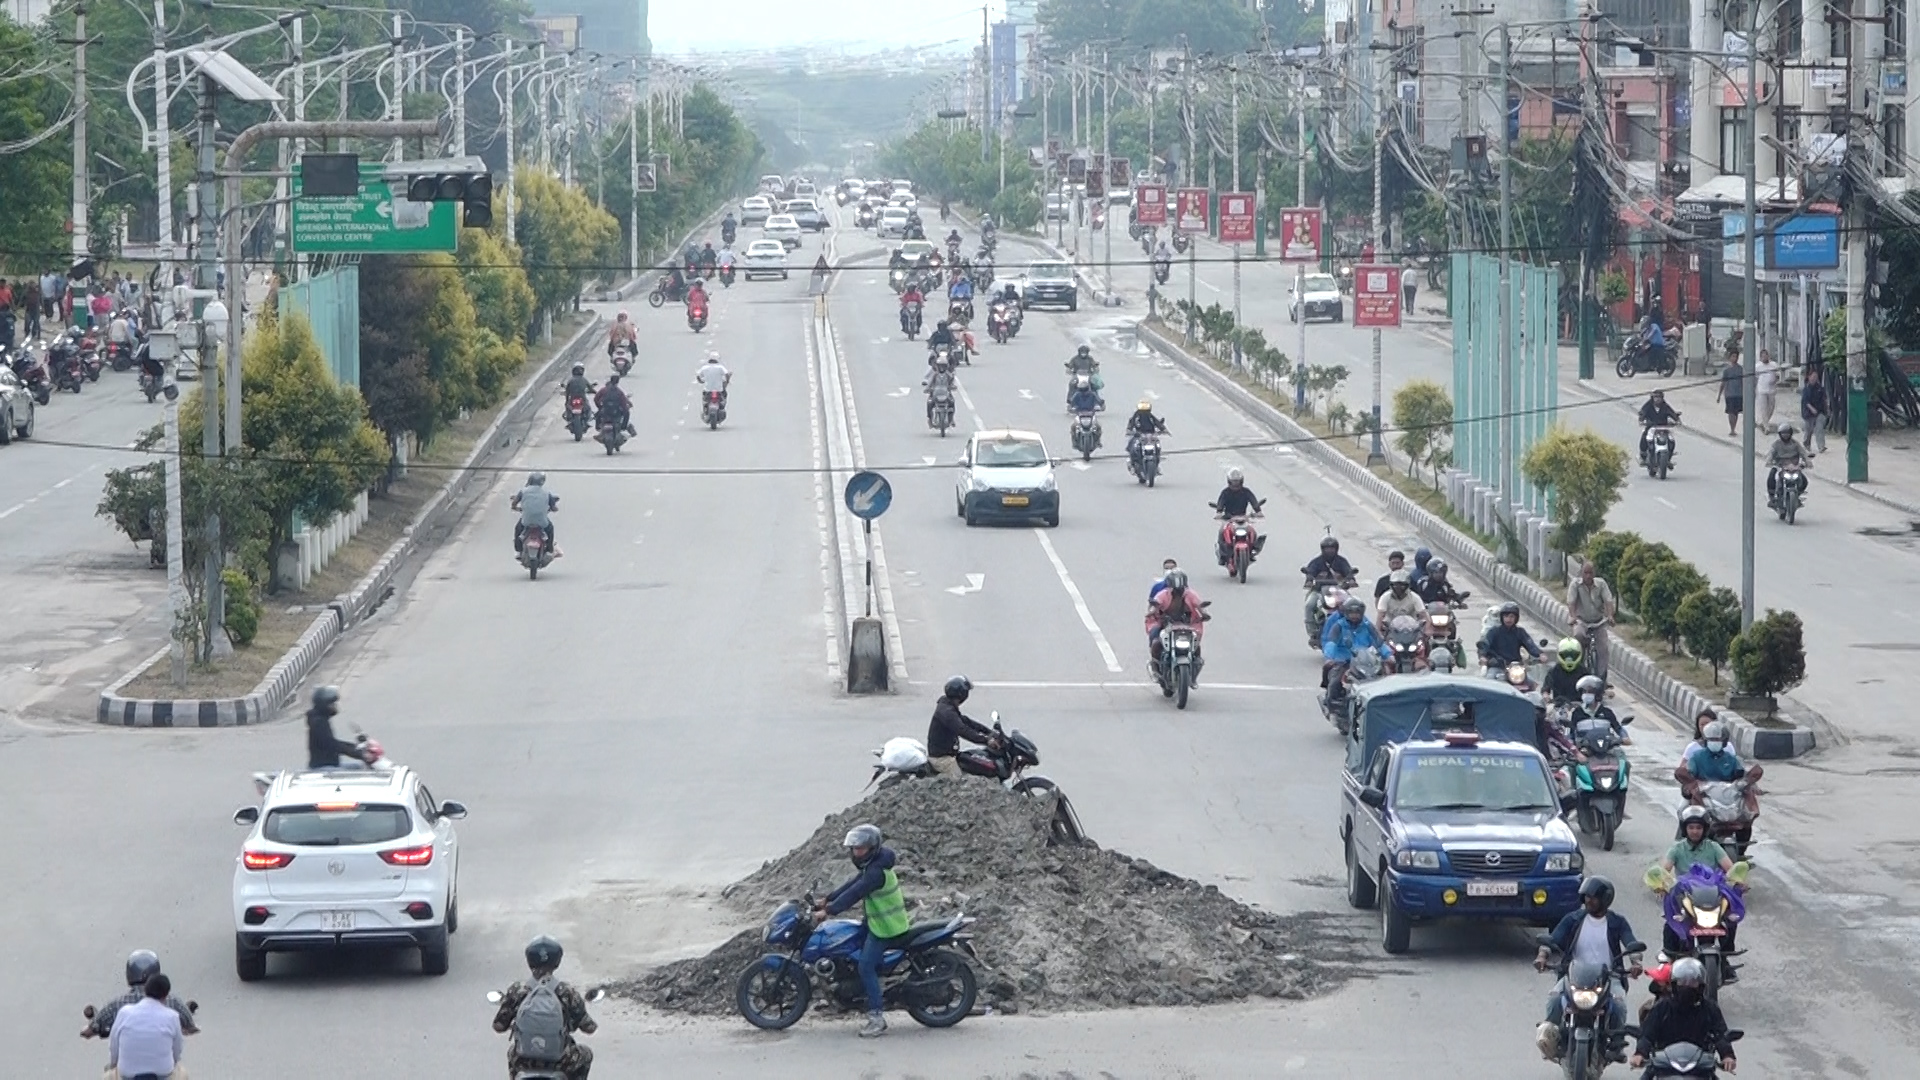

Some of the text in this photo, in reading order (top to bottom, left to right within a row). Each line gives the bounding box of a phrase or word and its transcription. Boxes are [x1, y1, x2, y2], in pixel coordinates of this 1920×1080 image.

[334, 223, 389, 231] INTERNATIONAL
[296, 233, 373, 242] CONVENTION CENTRE
[1417, 757, 1525, 768] NEPAL POLICE
